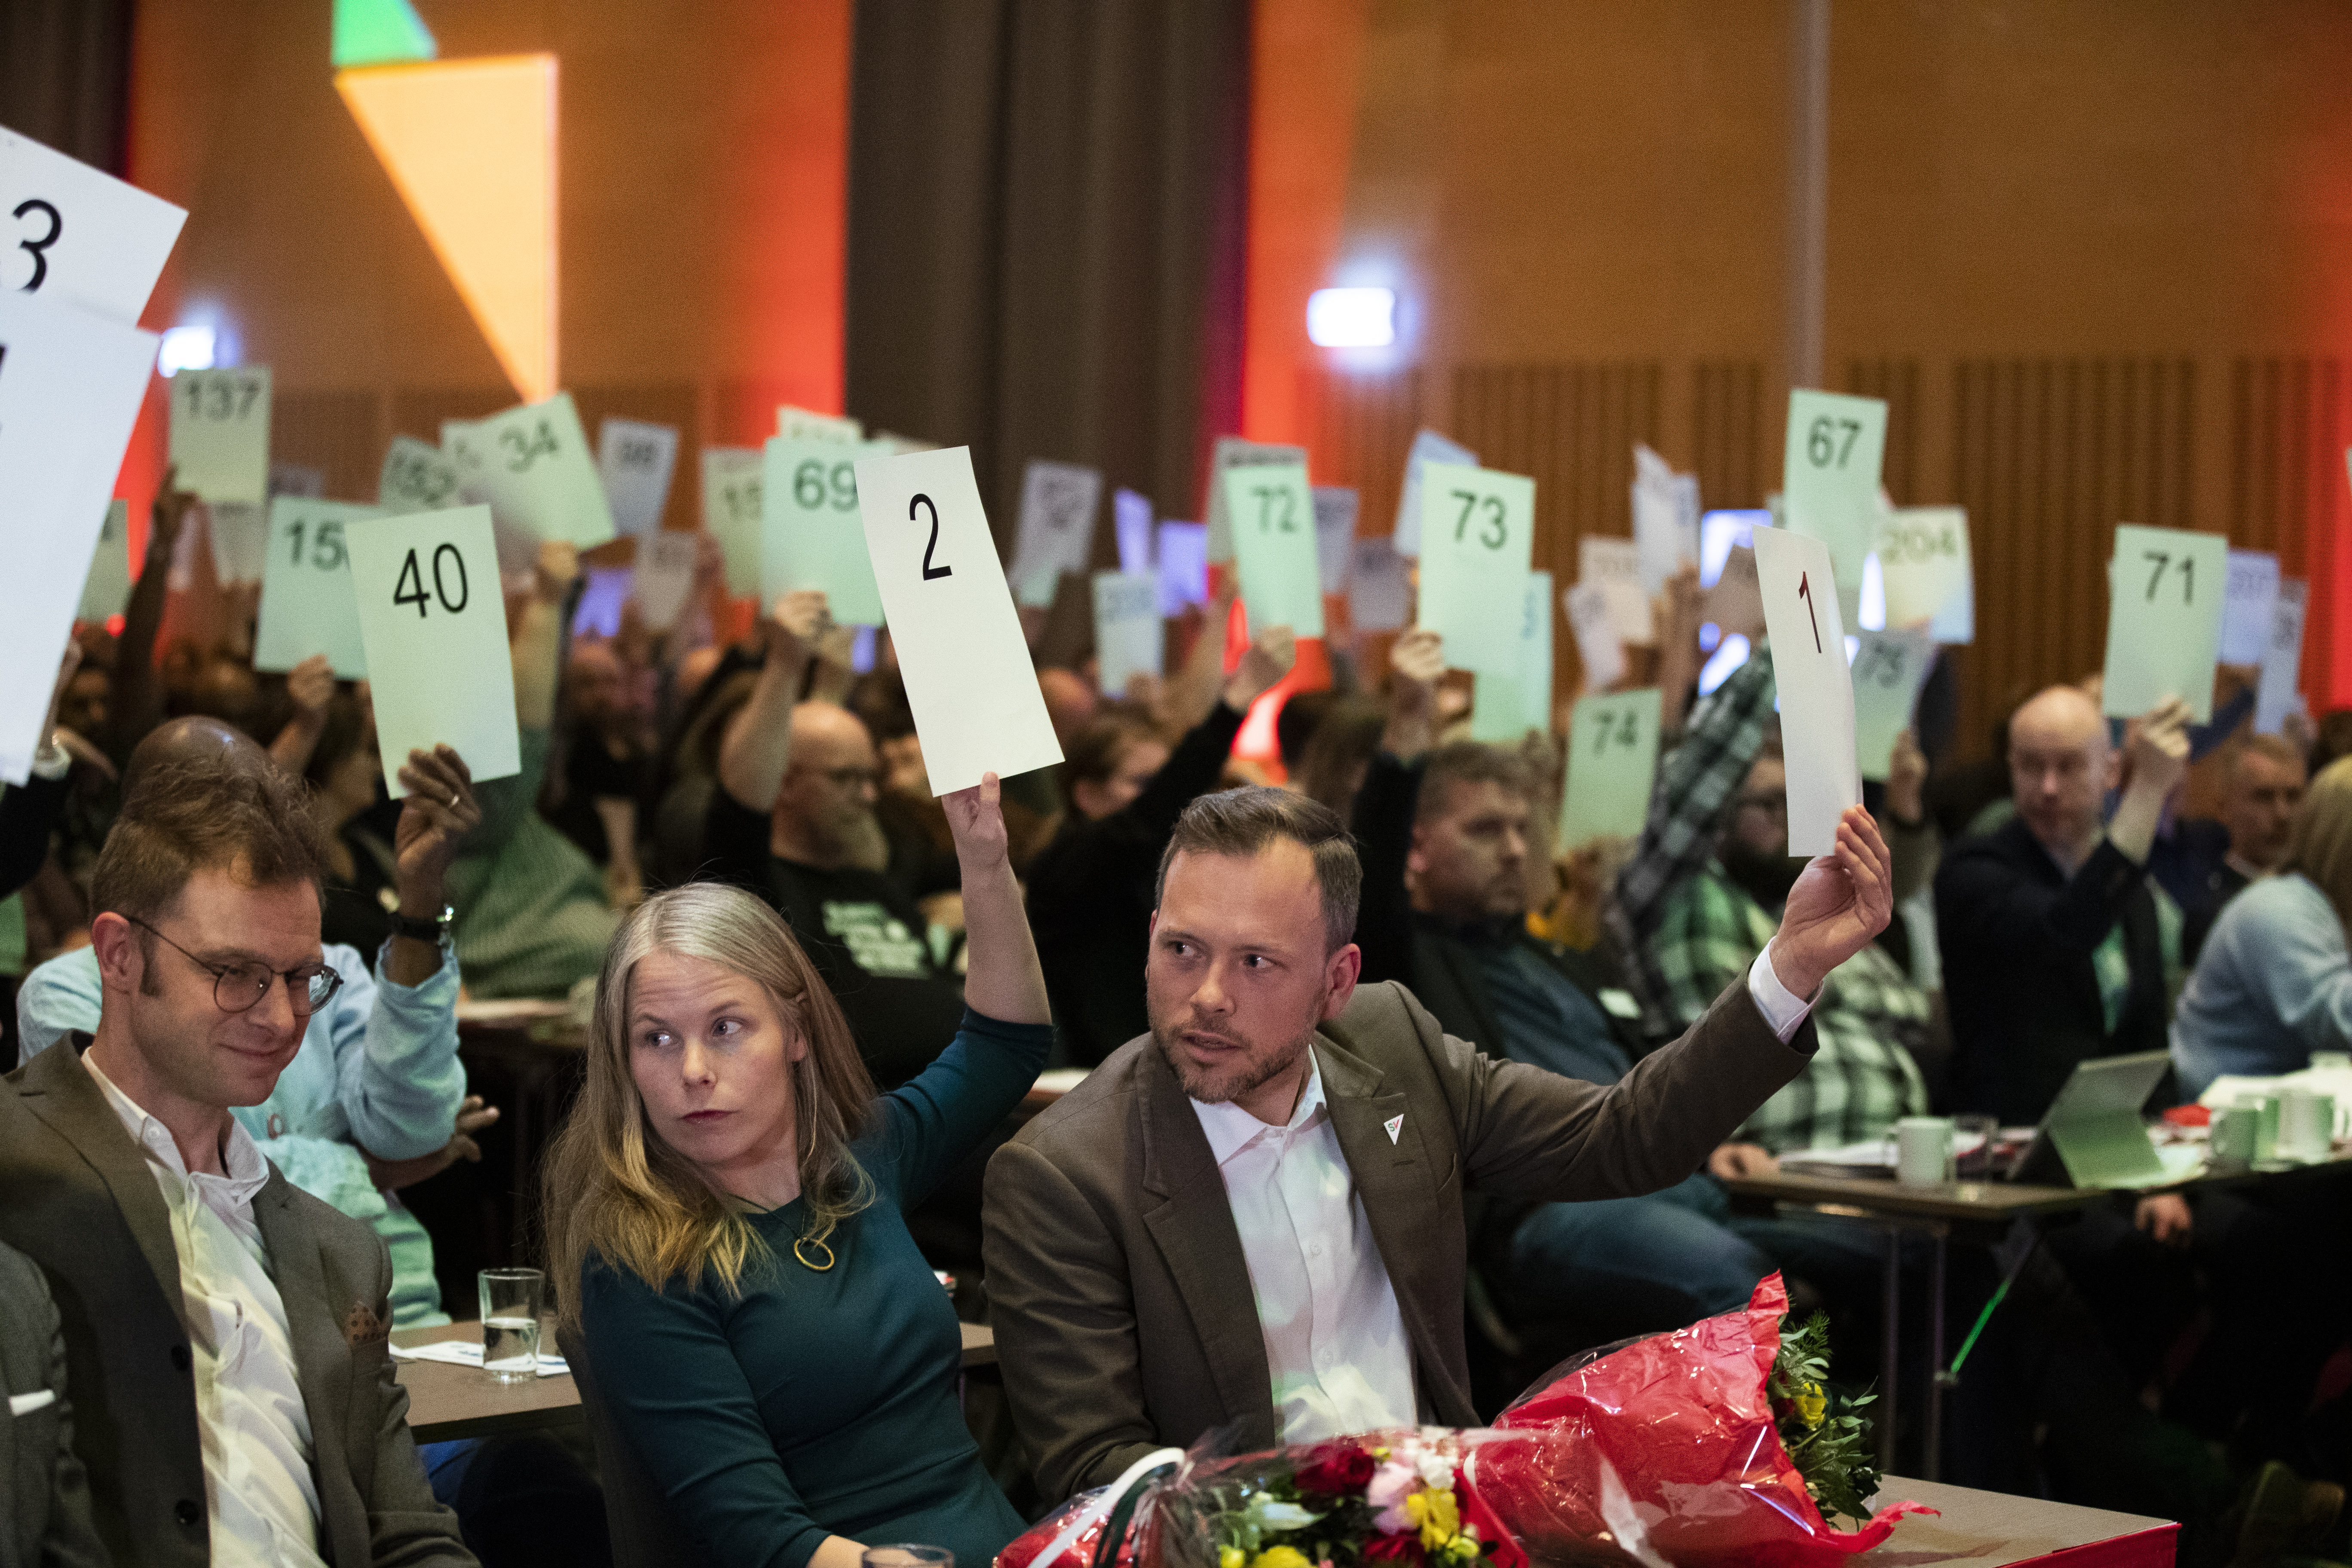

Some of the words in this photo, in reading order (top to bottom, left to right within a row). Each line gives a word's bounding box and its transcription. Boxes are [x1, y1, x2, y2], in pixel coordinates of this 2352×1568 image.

[12, 199, 63, 294] 3
[186, 377, 259, 422] 137
[499, 418, 559, 473] 34
[1807, 413, 1861, 469] 67
[793, 458, 858, 512] 69
[1251, 485, 1299, 534] 72
[909, 493, 952, 581] 2
[1450, 488, 1508, 550] 73
[393, 543, 469, 618] 40
[2144, 549, 2195, 605] 71
[1798, 571, 1822, 654] 1
[1592, 708, 1638, 757] 74
[1388, 1119, 1400, 1131] SV
